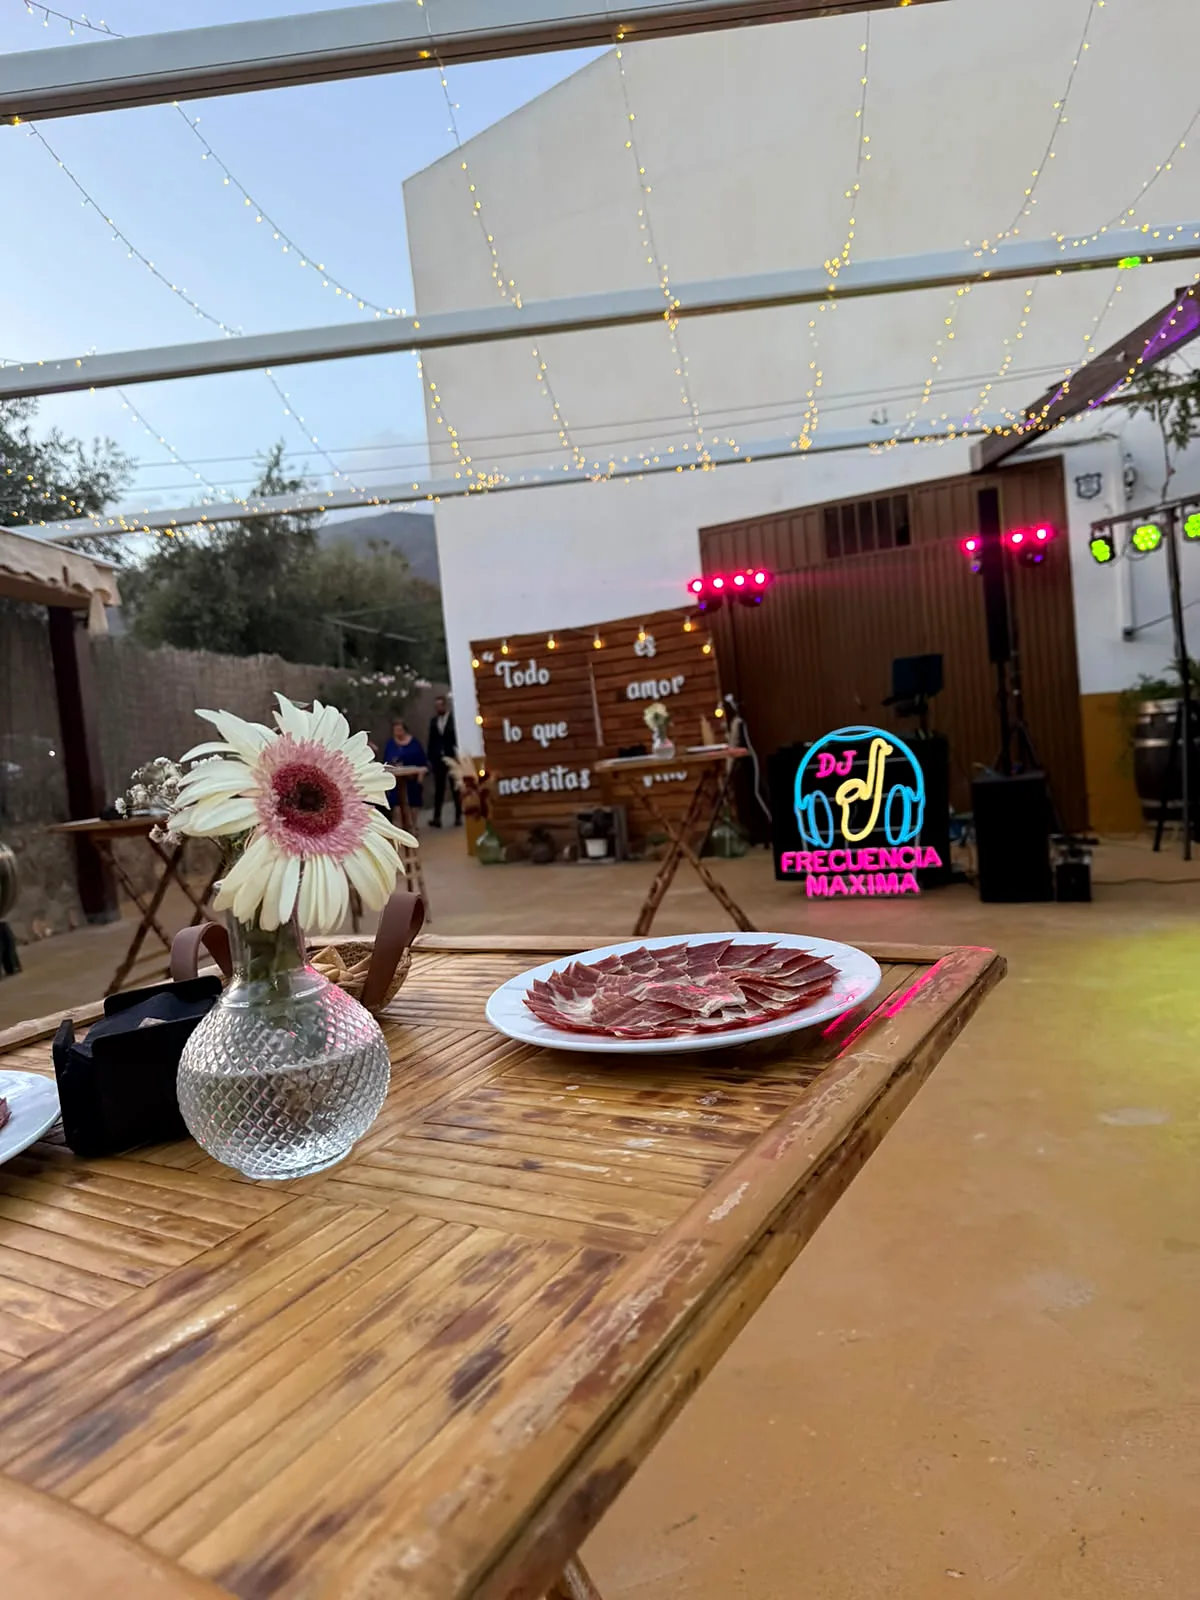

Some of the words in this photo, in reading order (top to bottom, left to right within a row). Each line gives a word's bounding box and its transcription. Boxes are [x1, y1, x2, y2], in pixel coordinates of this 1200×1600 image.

[627, 675, 685, 699] amor
[503, 719, 522, 742] lo
[532, 722, 568, 747] que
[816, 750, 857, 778] DJ
[498, 766, 591, 795] necesitas
[781, 847, 942, 872] FRECUENCIA
[806, 872, 920, 898] MAXIMA
